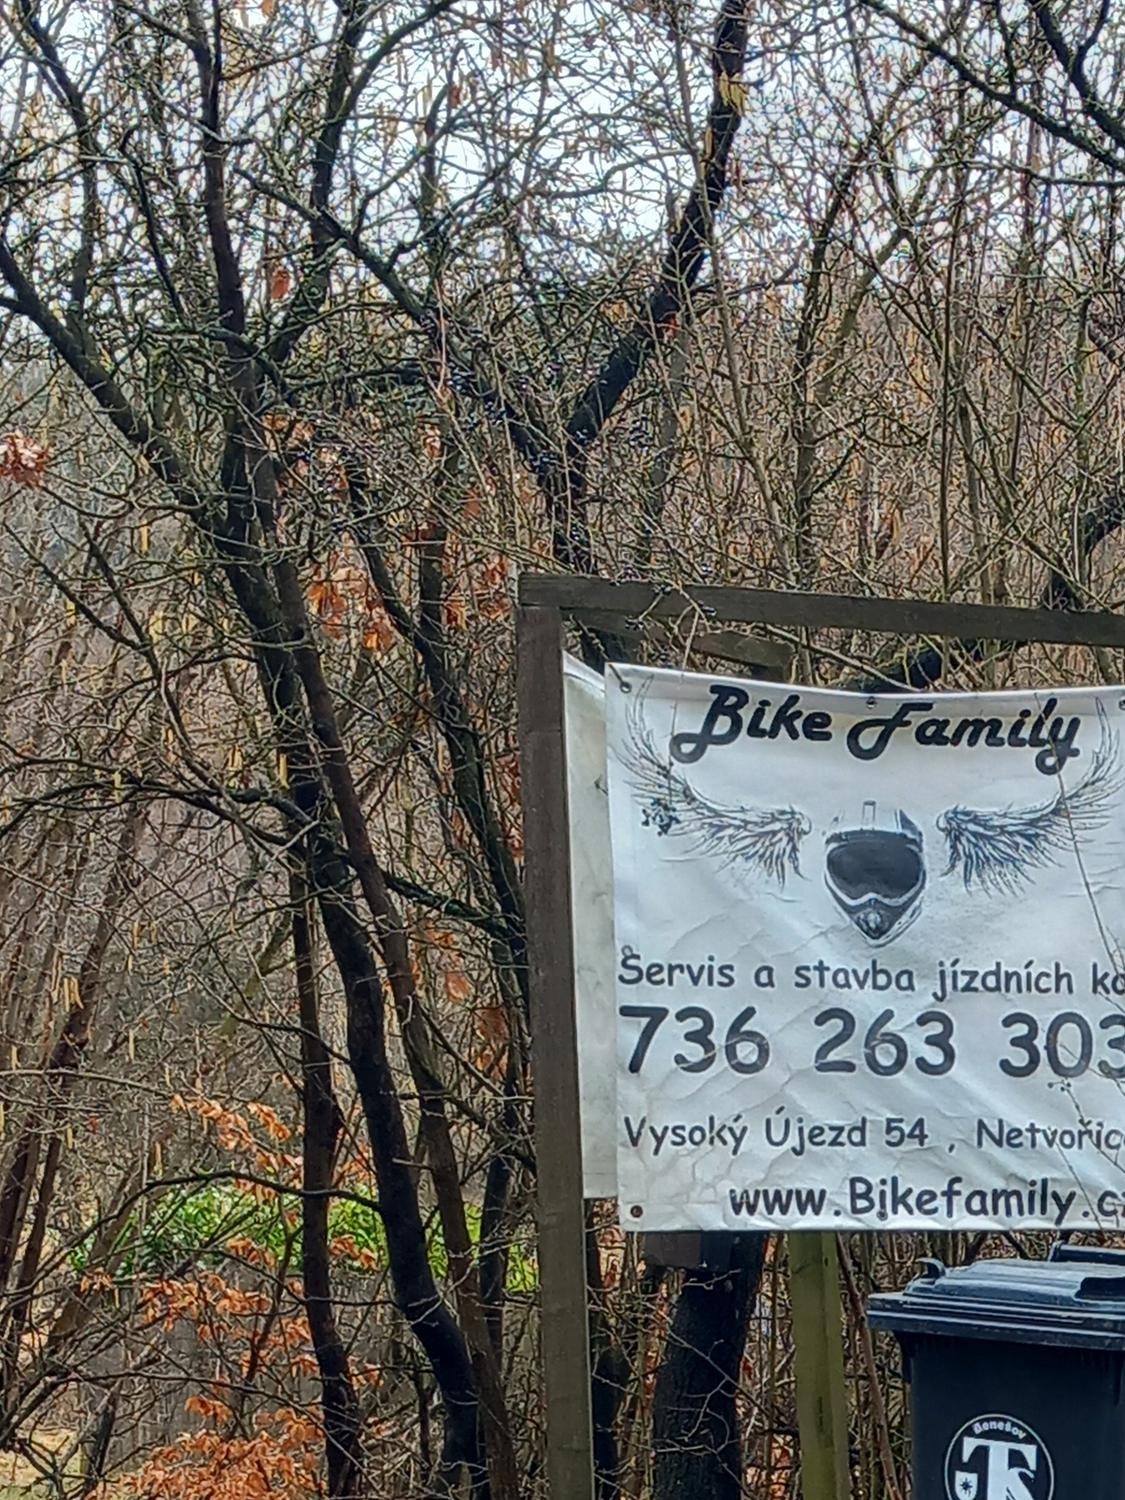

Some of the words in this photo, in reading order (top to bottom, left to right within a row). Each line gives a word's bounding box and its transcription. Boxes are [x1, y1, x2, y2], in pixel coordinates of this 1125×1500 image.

[670, 684, 833, 763] Bike
[846, 698, 1081, 775] Family
[618, 954, 735, 987] Servis
[754, 965, 775, 988] a
[794, 959, 916, 992] stavba
[932, 958, 1074, 1002] jízdních
[619, 1005, 770, 1075] 736
[814, 1008, 956, 1077] 263
[624, 1114, 748, 1156] Vysoký
[765, 1106, 867, 1157] Újezd
[885, 1118, 928, 1148] 54
